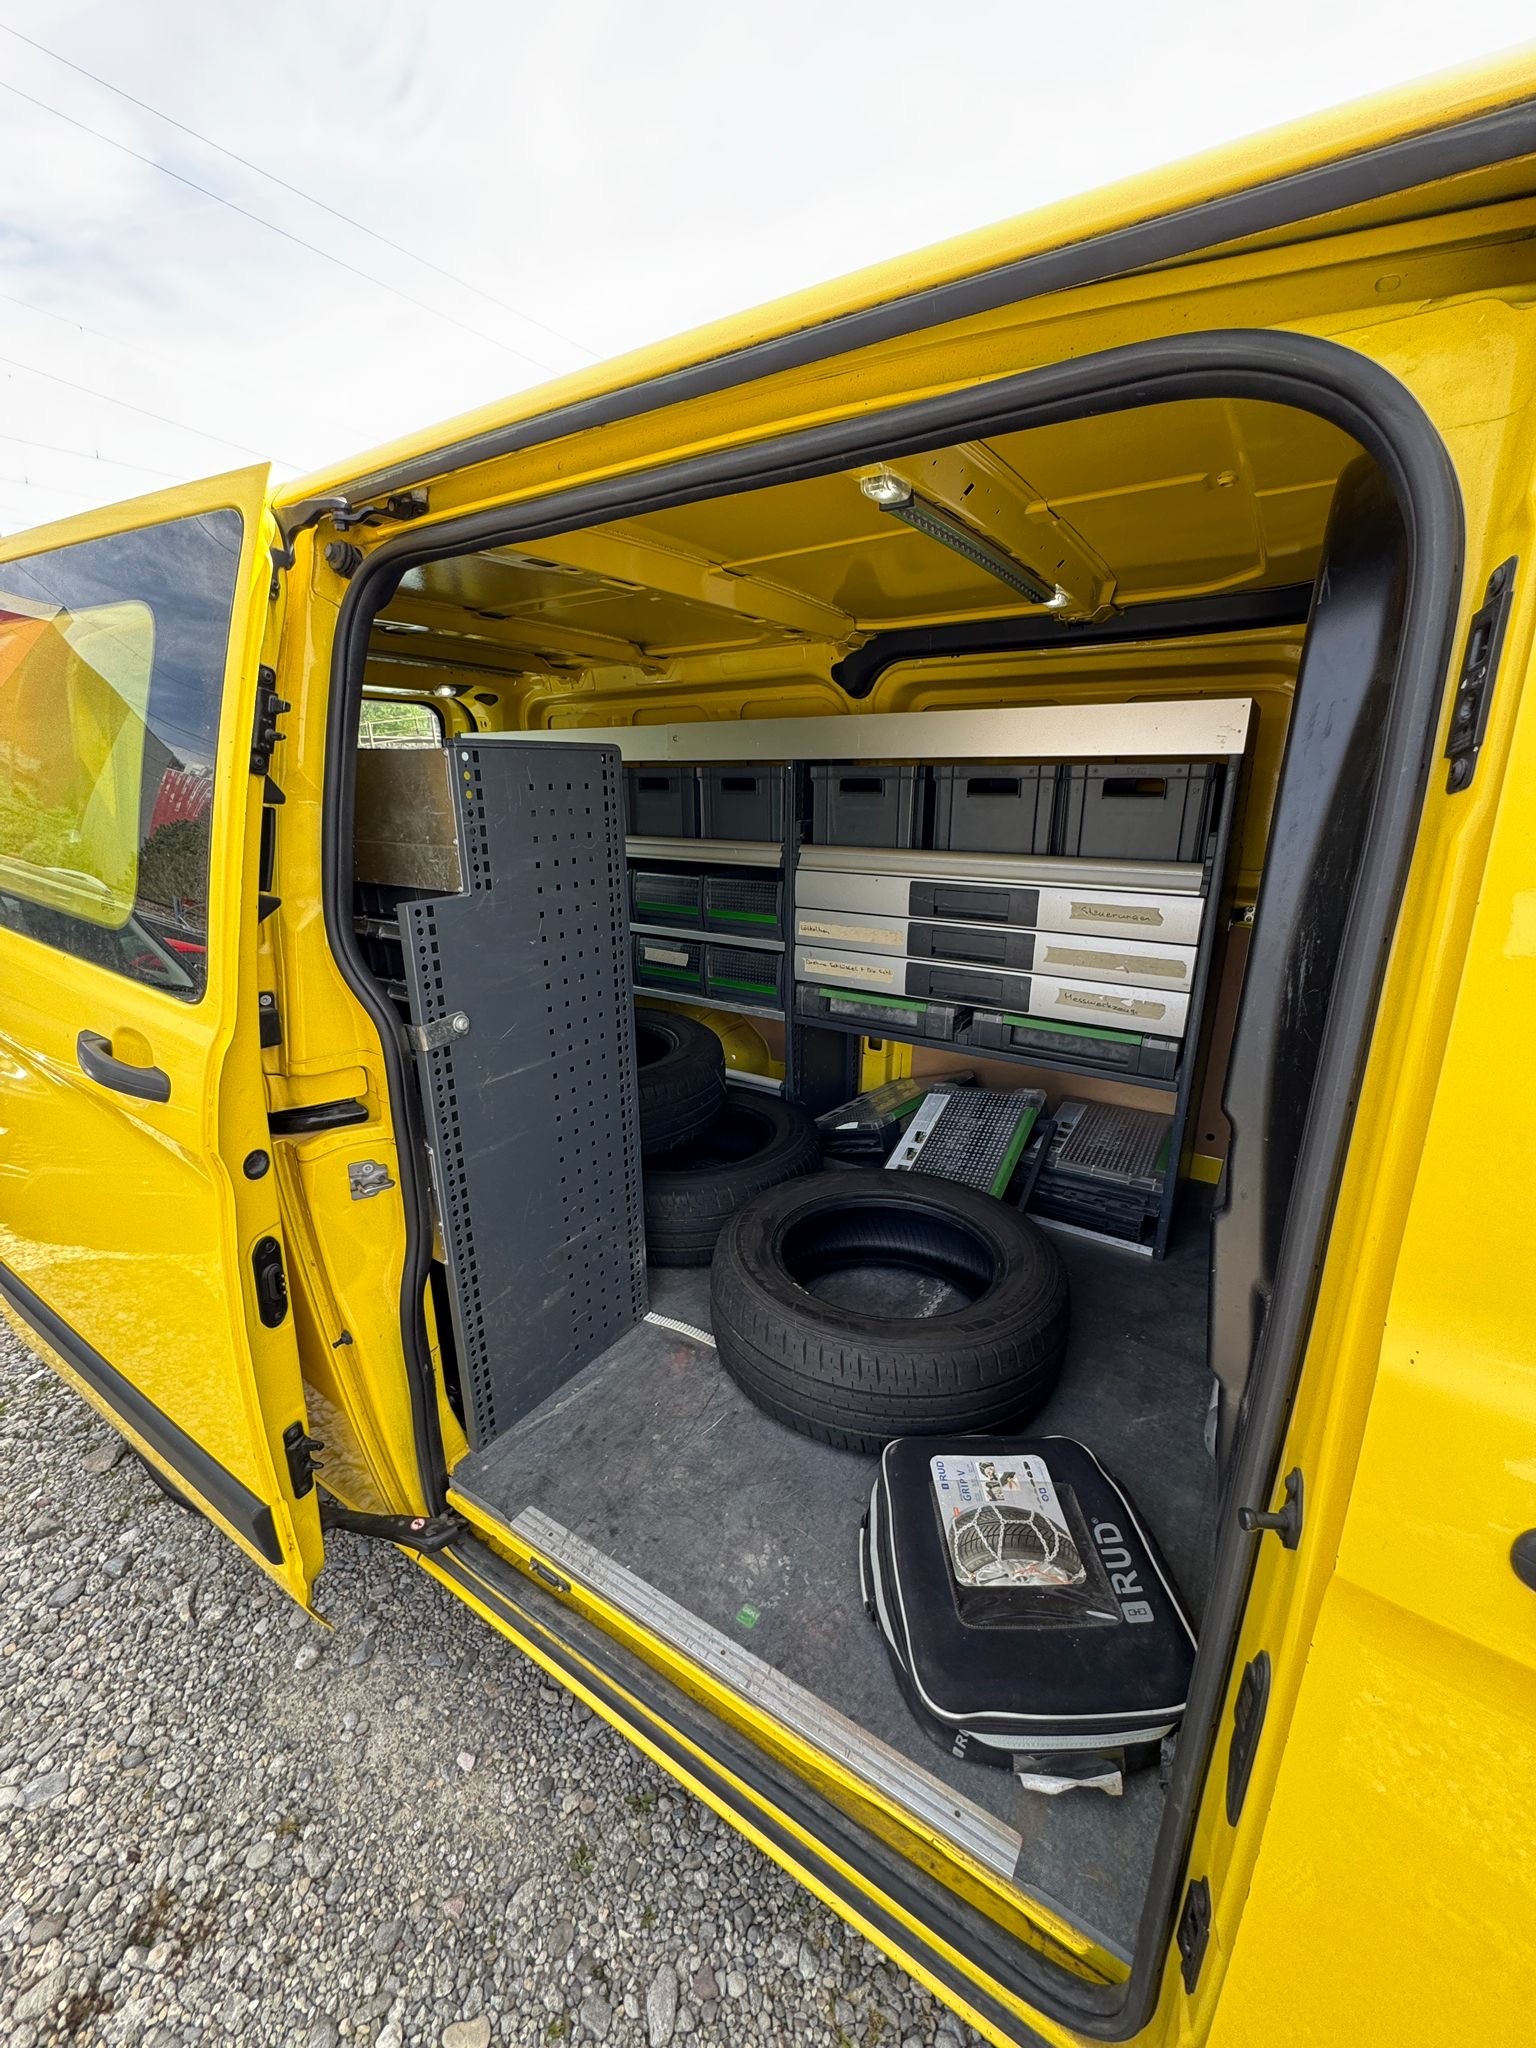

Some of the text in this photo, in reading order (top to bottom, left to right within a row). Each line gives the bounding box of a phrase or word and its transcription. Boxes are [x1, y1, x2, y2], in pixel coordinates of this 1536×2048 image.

[936, 1461, 949, 1483] RUD
[960, 1479, 972, 1502] GRIP
[1094, 1522, 1144, 1594] RUD
[955, 1729, 970, 1749] RU
